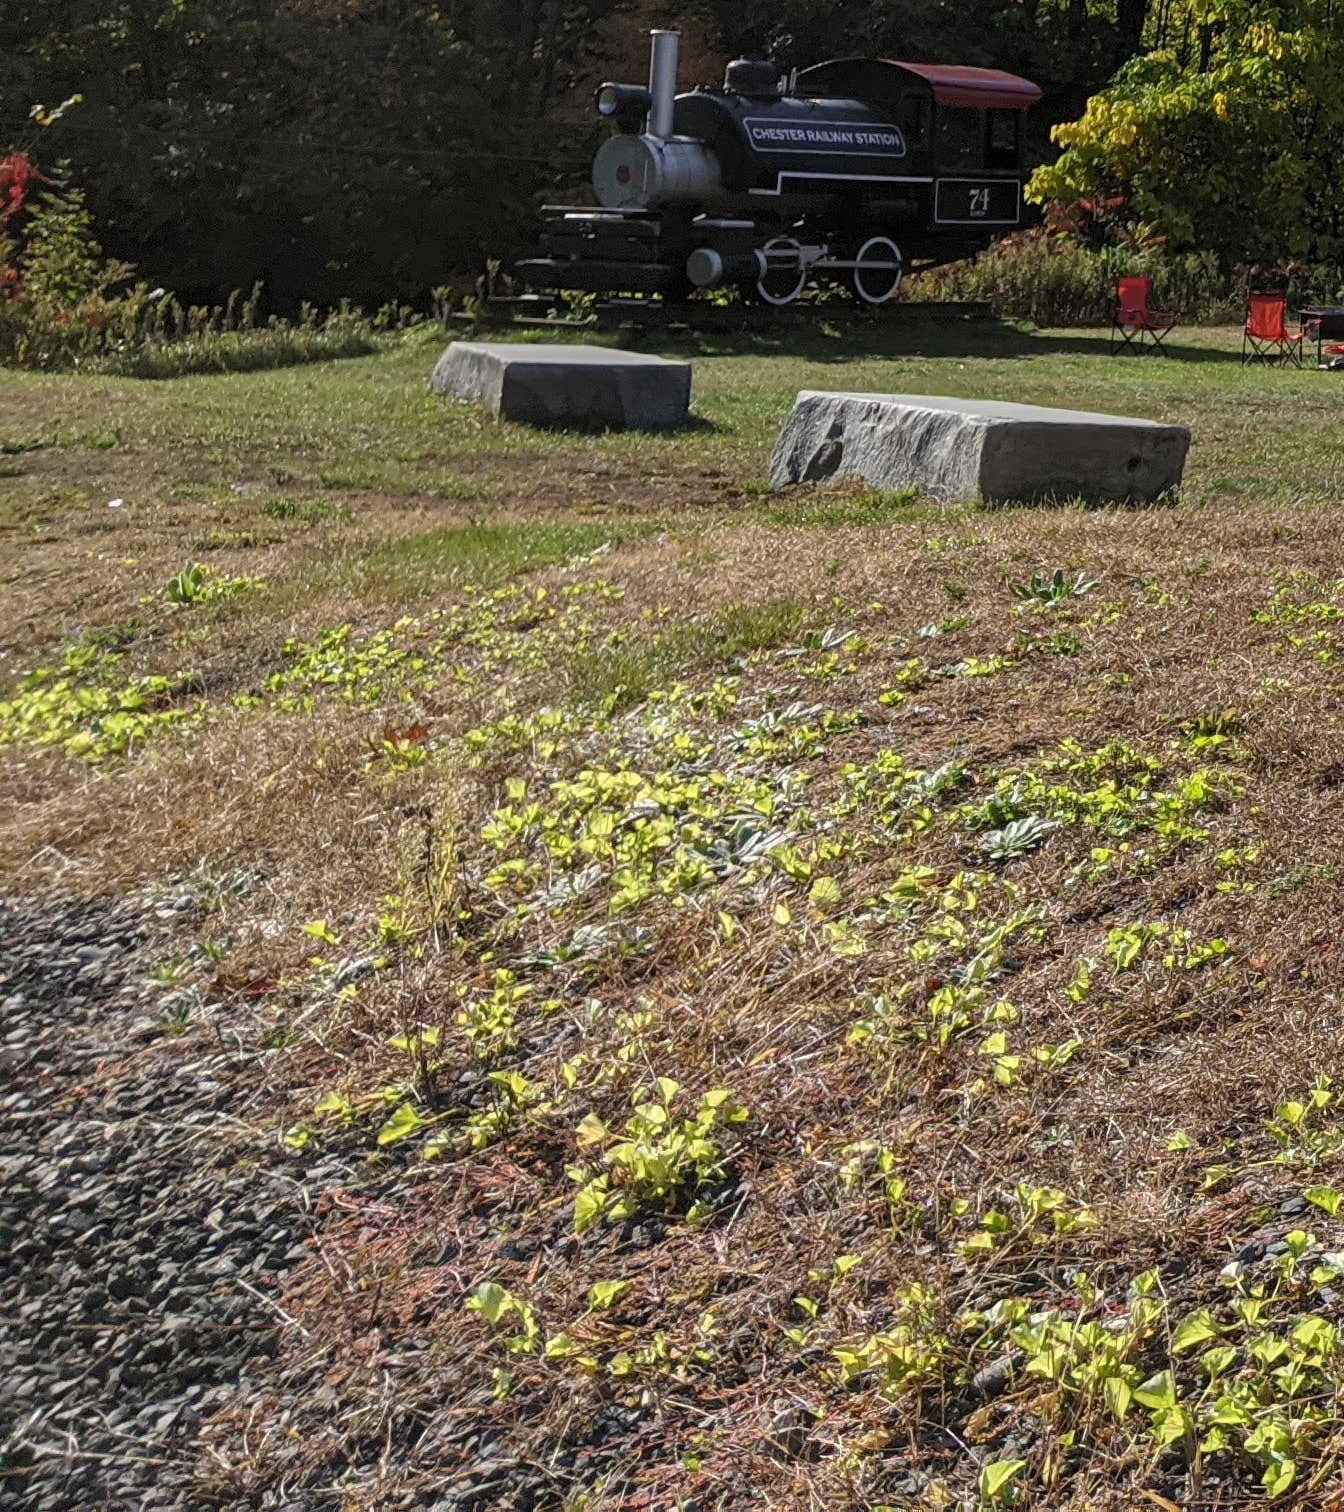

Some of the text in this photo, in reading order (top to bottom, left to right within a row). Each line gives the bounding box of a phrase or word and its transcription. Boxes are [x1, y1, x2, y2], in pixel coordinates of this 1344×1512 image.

[752, 127, 900, 147] CHESTER RAILWAY STATION
[968, 188, 990, 211] 74
